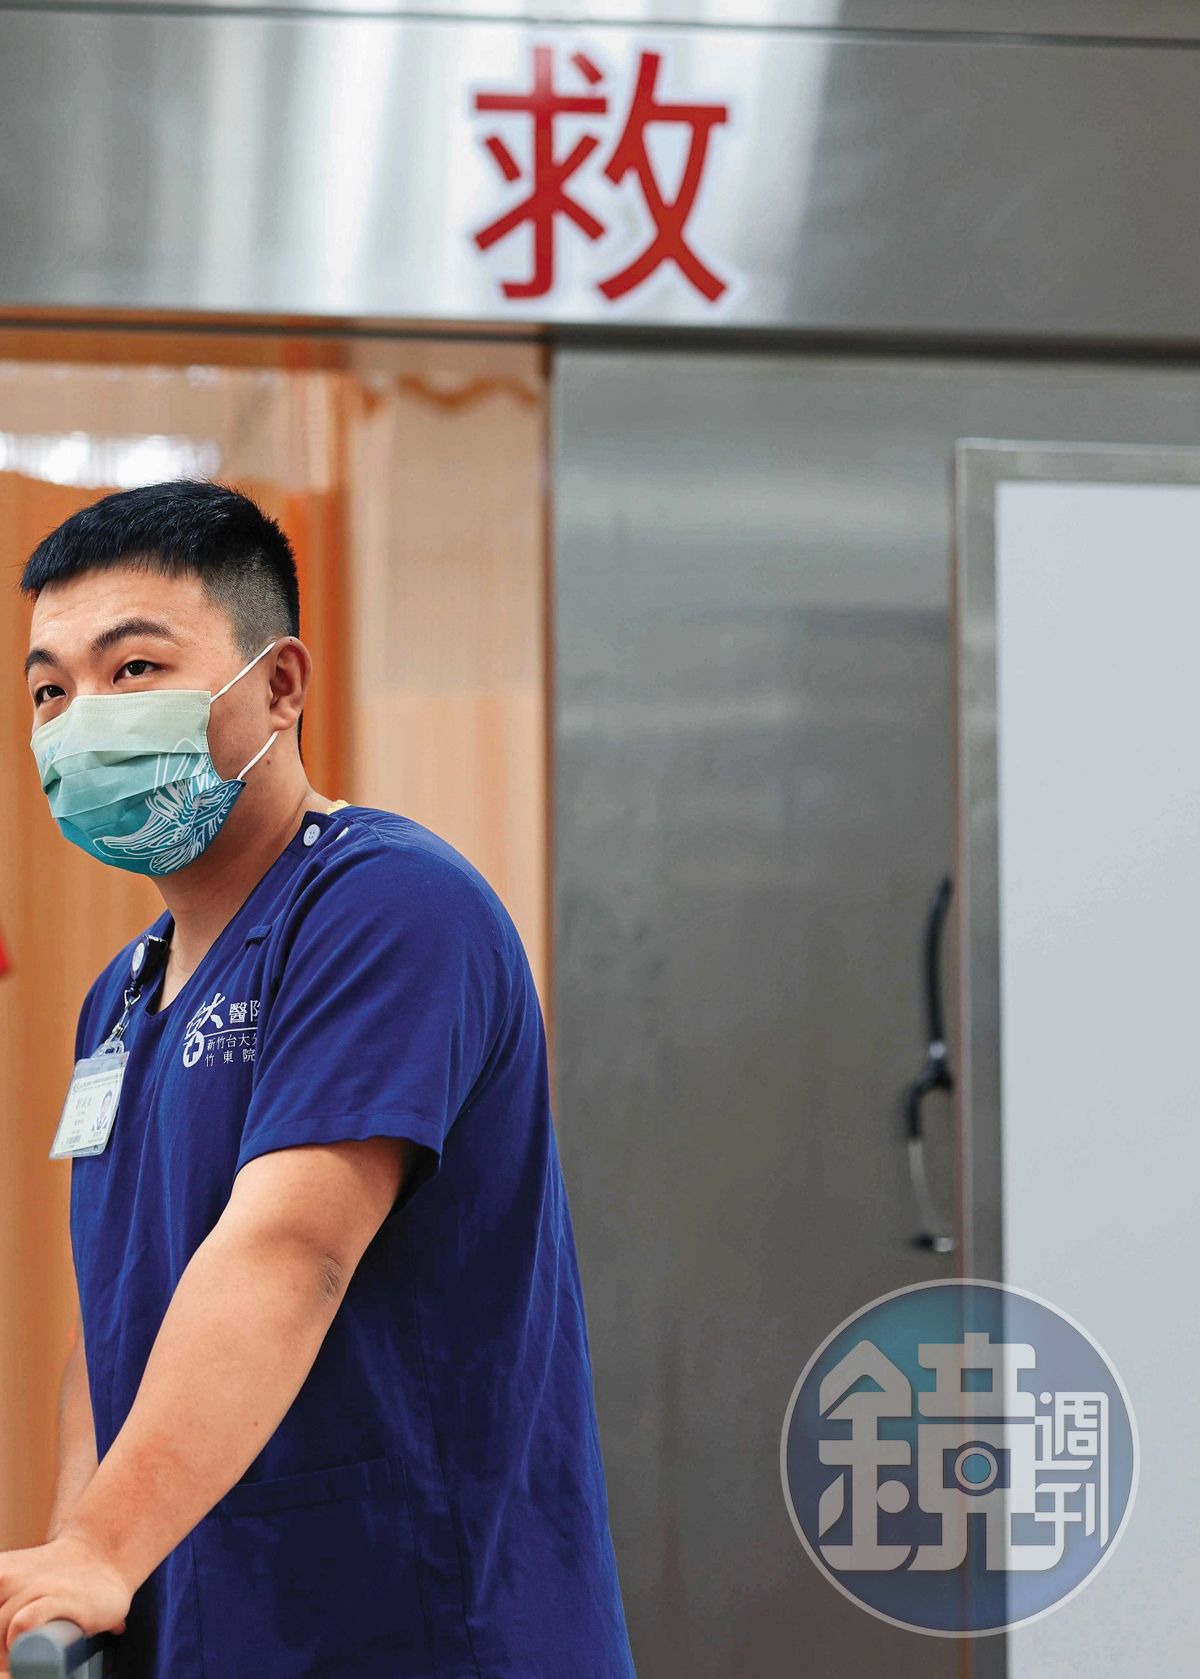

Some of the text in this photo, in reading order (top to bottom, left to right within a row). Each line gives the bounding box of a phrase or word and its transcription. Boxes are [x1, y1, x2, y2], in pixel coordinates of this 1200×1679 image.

[474, 47, 728, 303] 救
[205, 1048, 256, 1067] 竹東院
